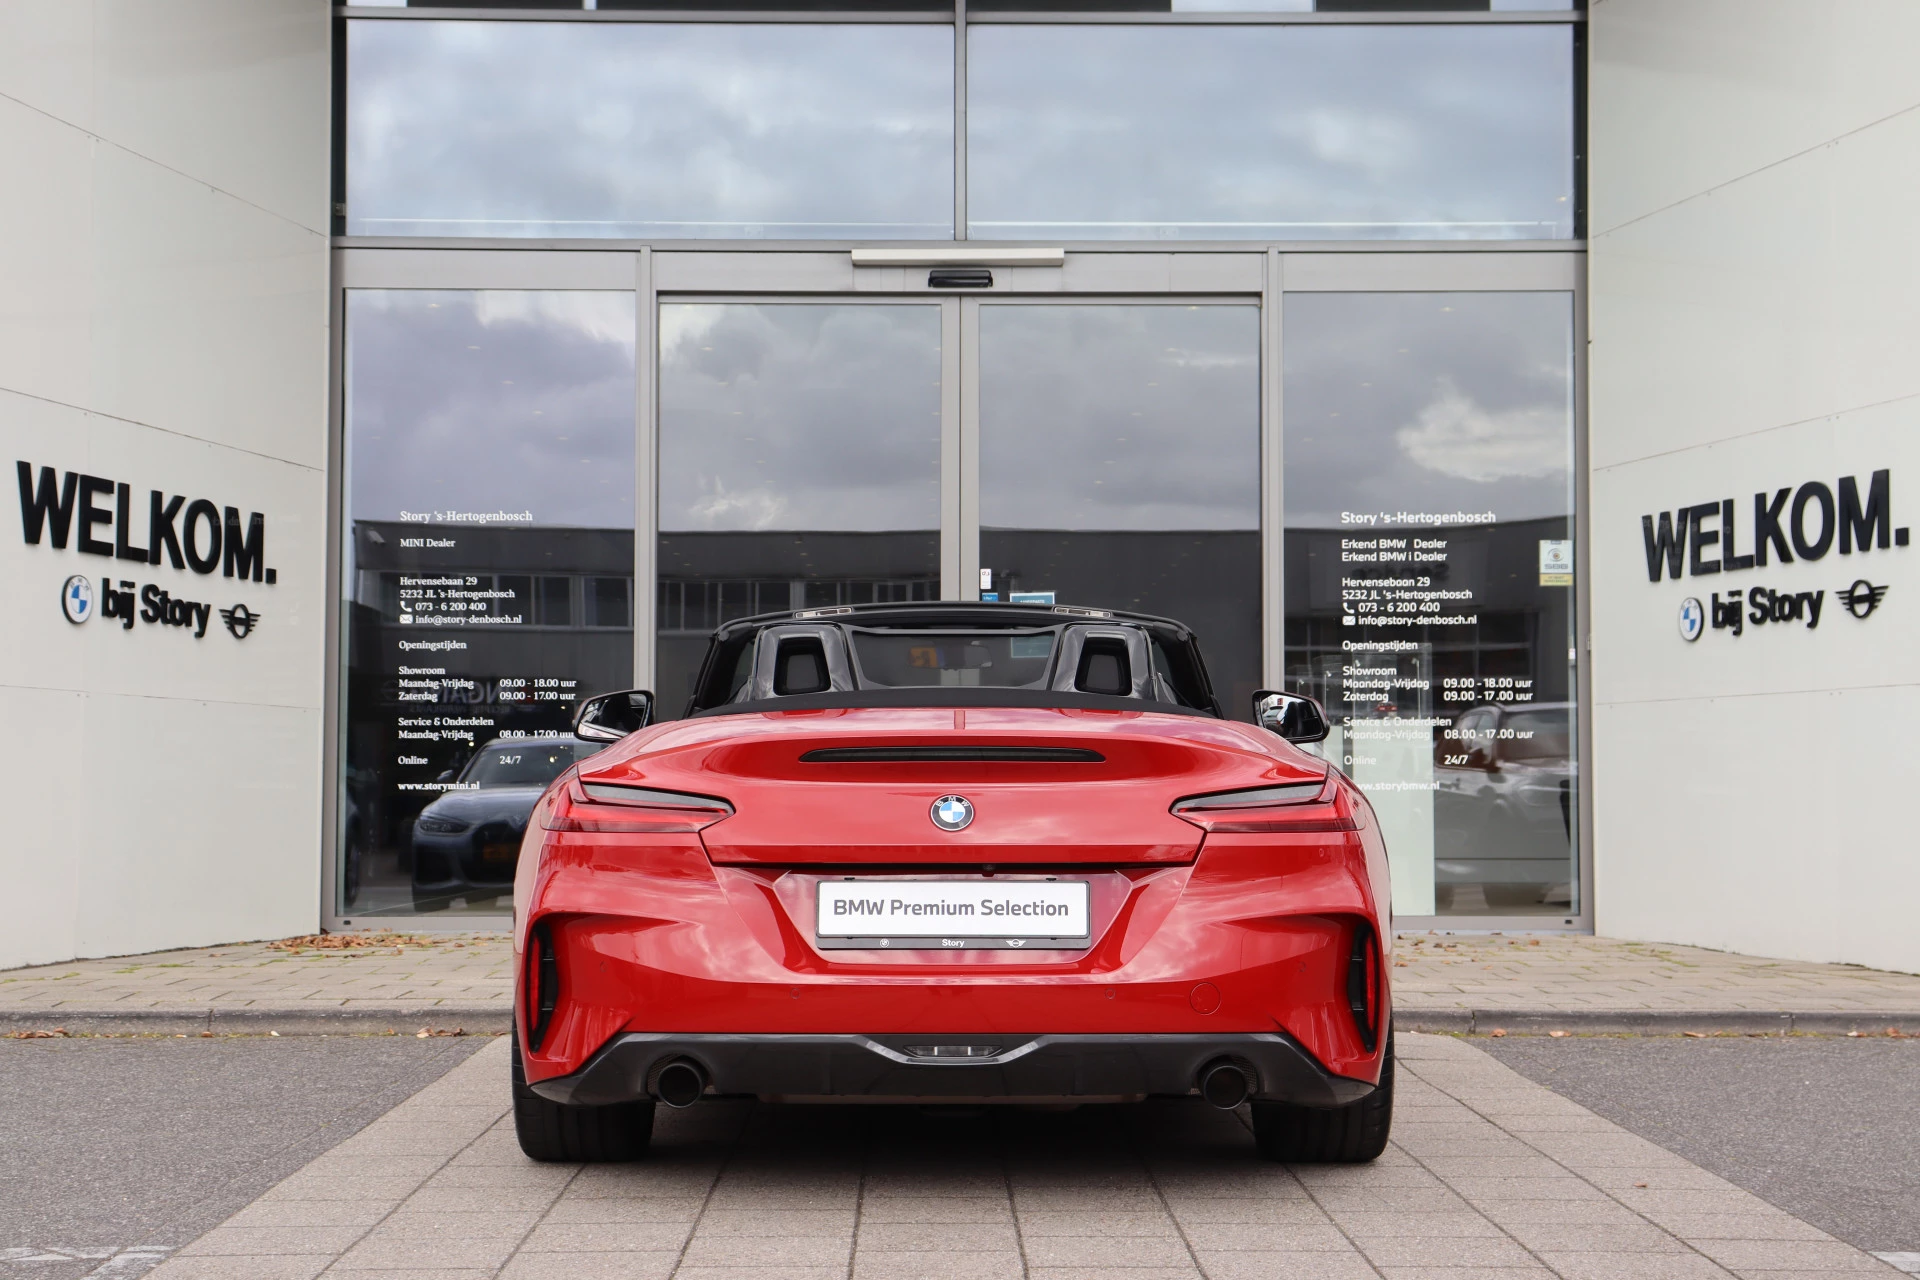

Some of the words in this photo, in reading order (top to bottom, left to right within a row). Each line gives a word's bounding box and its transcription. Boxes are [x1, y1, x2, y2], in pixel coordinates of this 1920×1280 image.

[16, 460, 277, 584] WELKOM.
[399, 511, 431, 523] Story
[1341, 512, 1377, 525] Story
[1641, 468, 1910, 582] WELKOM.
[400, 538, 424, 547] MINI
[426, 538, 456, 547] Dealer
[1341, 539, 1377, 549] Erkend
[1379, 540, 1407, 549] BMW
[1413, 539, 1447, 549] Dealer
[1341, 552, 1377, 562] Erkend
[1379, 553, 1407, 562] BMW
[1408, 552, 1412, 562] i
[1414, 552, 1447, 562] Dealer
[400, 576, 463, 586] Hervensebaan
[465, 577, 478, 585] 29
[1342, 577, 1415, 588] Hervensebaan
[1416, 577, 1431, 587] 29
[400, 590, 423, 598] 5232
[425, 590, 437, 599] JL
[1342, 590, 1368, 600] 5232
[1369, 590, 1381, 600] JL
[101, 577, 136, 630] bij
[140, 583, 211, 639] Story
[415, 602, 433, 611] 073
[441, 602, 448, 611] 6
[449, 602, 467, 611] 200
[468, 602, 487, 611] 400
[1358, 602, 1380, 612] 073
[1387, 602, 1394, 612] 6
[1395, 602, 1417, 612] 200
[1418, 602, 1440, 612] 400
[1711, 590, 1743, 636] bij
[1748, 586, 1825, 629] Story
[415, 614, 522, 626] info@story-denbosch.nl
[1358, 615, 1477, 626] info@story-denbosch.nl
[398, 641, 467, 651] Openingstijden
[1342, 641, 1418, 651] Openingstijden
[398, 666, 446, 675] Showroom
[1343, 666, 1397, 676] Showroom
[399, 679, 474, 690] Maandag-Vrijdag
[499, 679, 526, 688] 09.00
[533, 679, 558, 688] 18.00
[1343, 679, 1430, 690] Maandag-Vrijdag
[1443, 679, 1475, 689] 09.00
[1483, 679, 1513, 689] 18.00
[1514, 681, 1533, 689] uur
[398, 691, 438, 702] Zaterdag
[499, 692, 526, 701] 09.00
[533, 692, 558, 701] 17.00
[1343, 691, 1389, 702] Zaterdag
[1443, 692, 1475, 702] 09.00
[398, 718, 432, 726] Service
[433, 718, 440, 726] &
[442, 717, 494, 727] Onderdelen
[1343, 717, 1380, 727] Service
[1383, 717, 1389, 727] &
[1392, 716, 1452, 727] Onderdelen
[398, 730, 474, 741] Maandag-Vrijdag
[499, 730, 526, 739] 08.00
[533, 730, 558, 739] 17.00
[1344, 730, 1430, 741] Maandag-Vrijdag
[1444, 730, 1476, 740] 08.00
[1516, 732, 1534, 740] uur
[398, 756, 428, 765] Online
[499, 756, 521, 765] 24/7
[1344, 755, 1377, 765] Online
[1444, 755, 1468, 765] 24/7
[398, 781, 480, 792] www.storymini.nl
[833, 899, 885, 916] BMW
[890, 899, 975, 916] Premium
[980, 899, 1069, 916] Selection
[941, 938, 965, 948] Story
